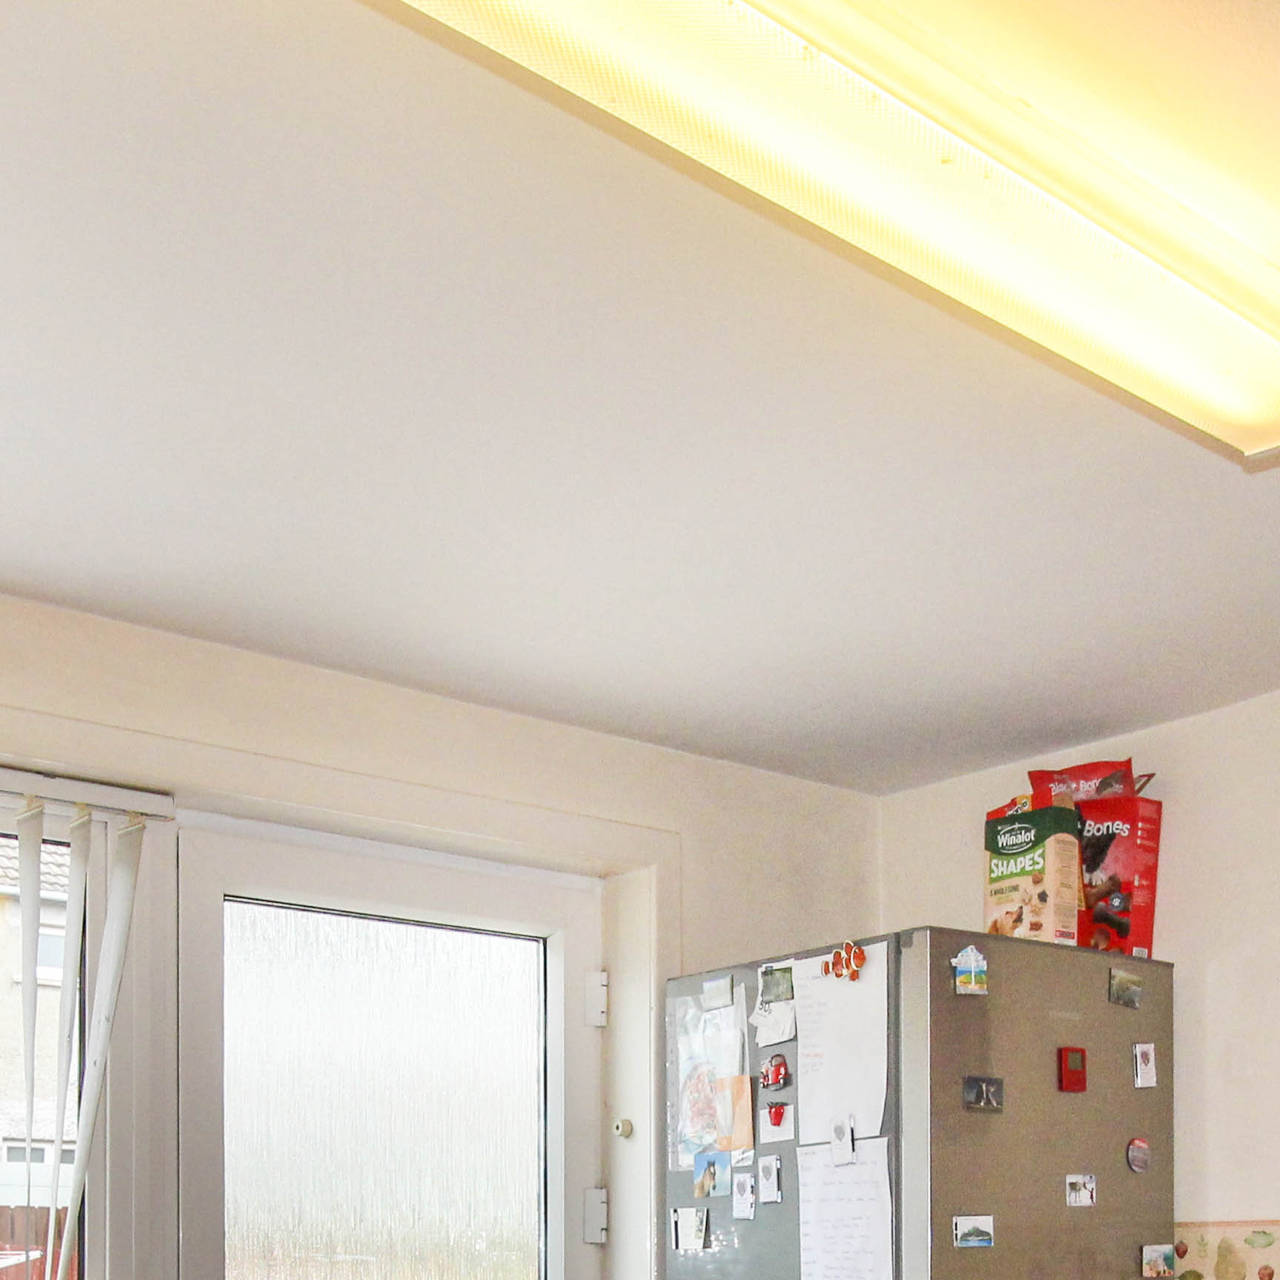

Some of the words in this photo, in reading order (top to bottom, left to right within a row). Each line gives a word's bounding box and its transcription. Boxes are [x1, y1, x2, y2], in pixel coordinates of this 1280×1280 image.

[1083, 819, 1131, 836] Bones
[997, 829, 1036, 848] Winalot
[991, 849, 1044, 878] SHAPES
